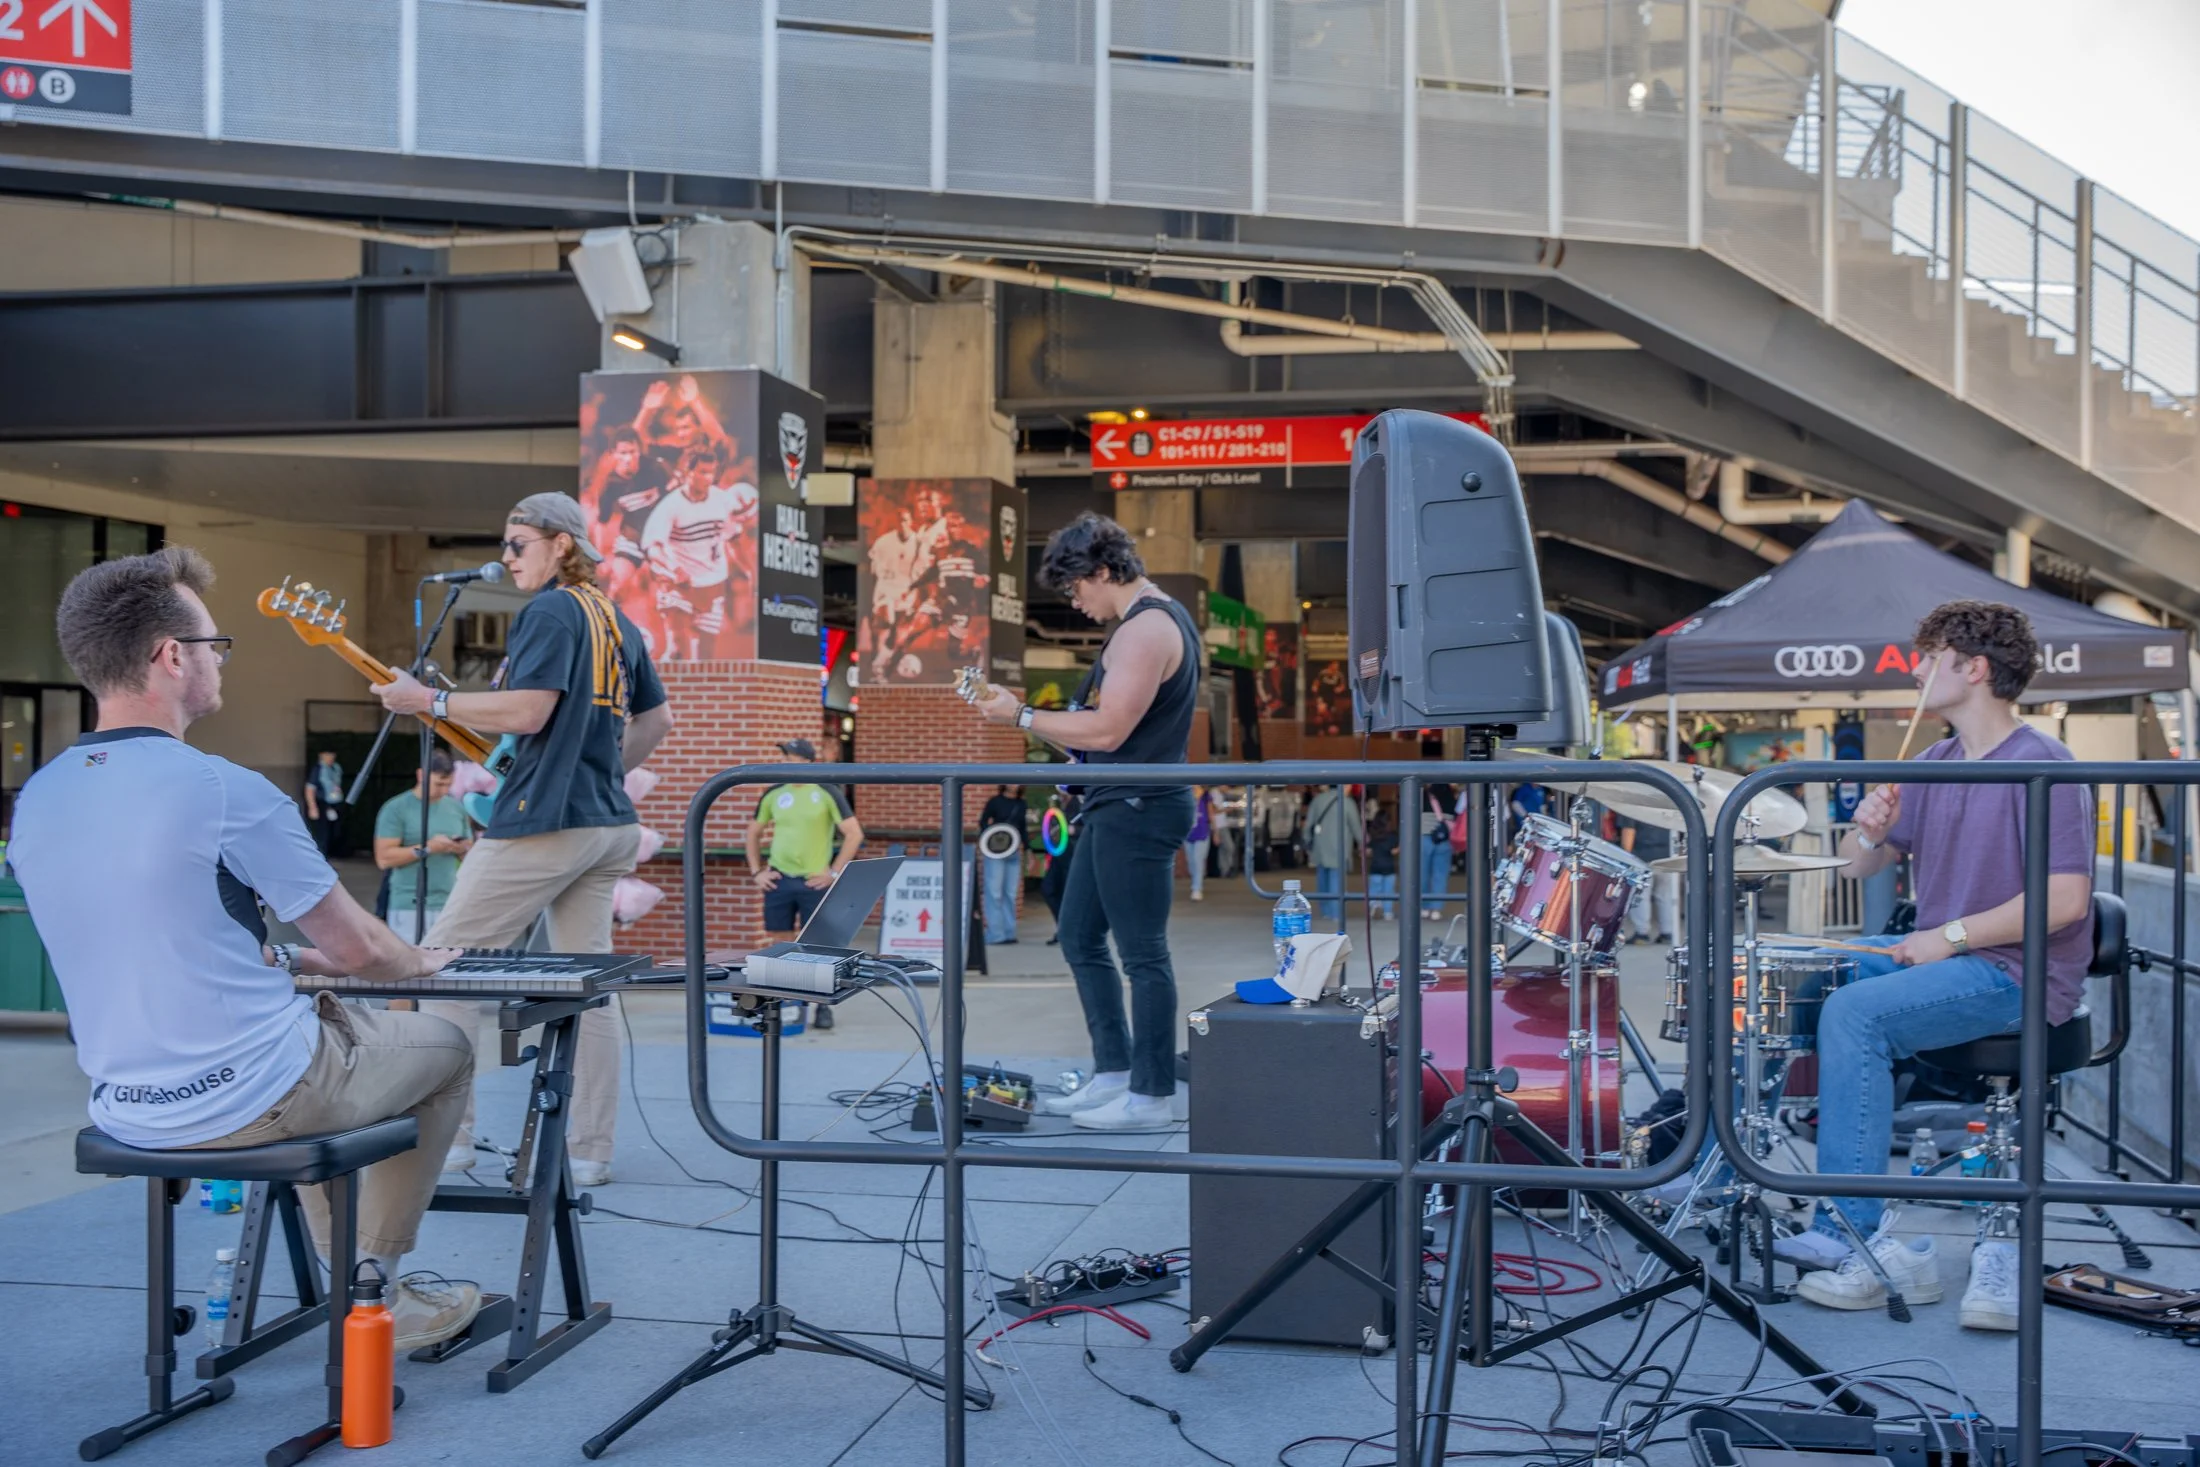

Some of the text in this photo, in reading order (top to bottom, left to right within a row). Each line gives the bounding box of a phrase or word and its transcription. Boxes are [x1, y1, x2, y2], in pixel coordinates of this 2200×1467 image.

[51, 78, 65, 95] B
[1132, 474, 1177, 486] Premium
[1178, 473, 1203, 488] Entry
[1210, 472, 1232, 485] Club
[1233, 472, 1262, 484] Level
[763, 532, 820, 578] HEROES
